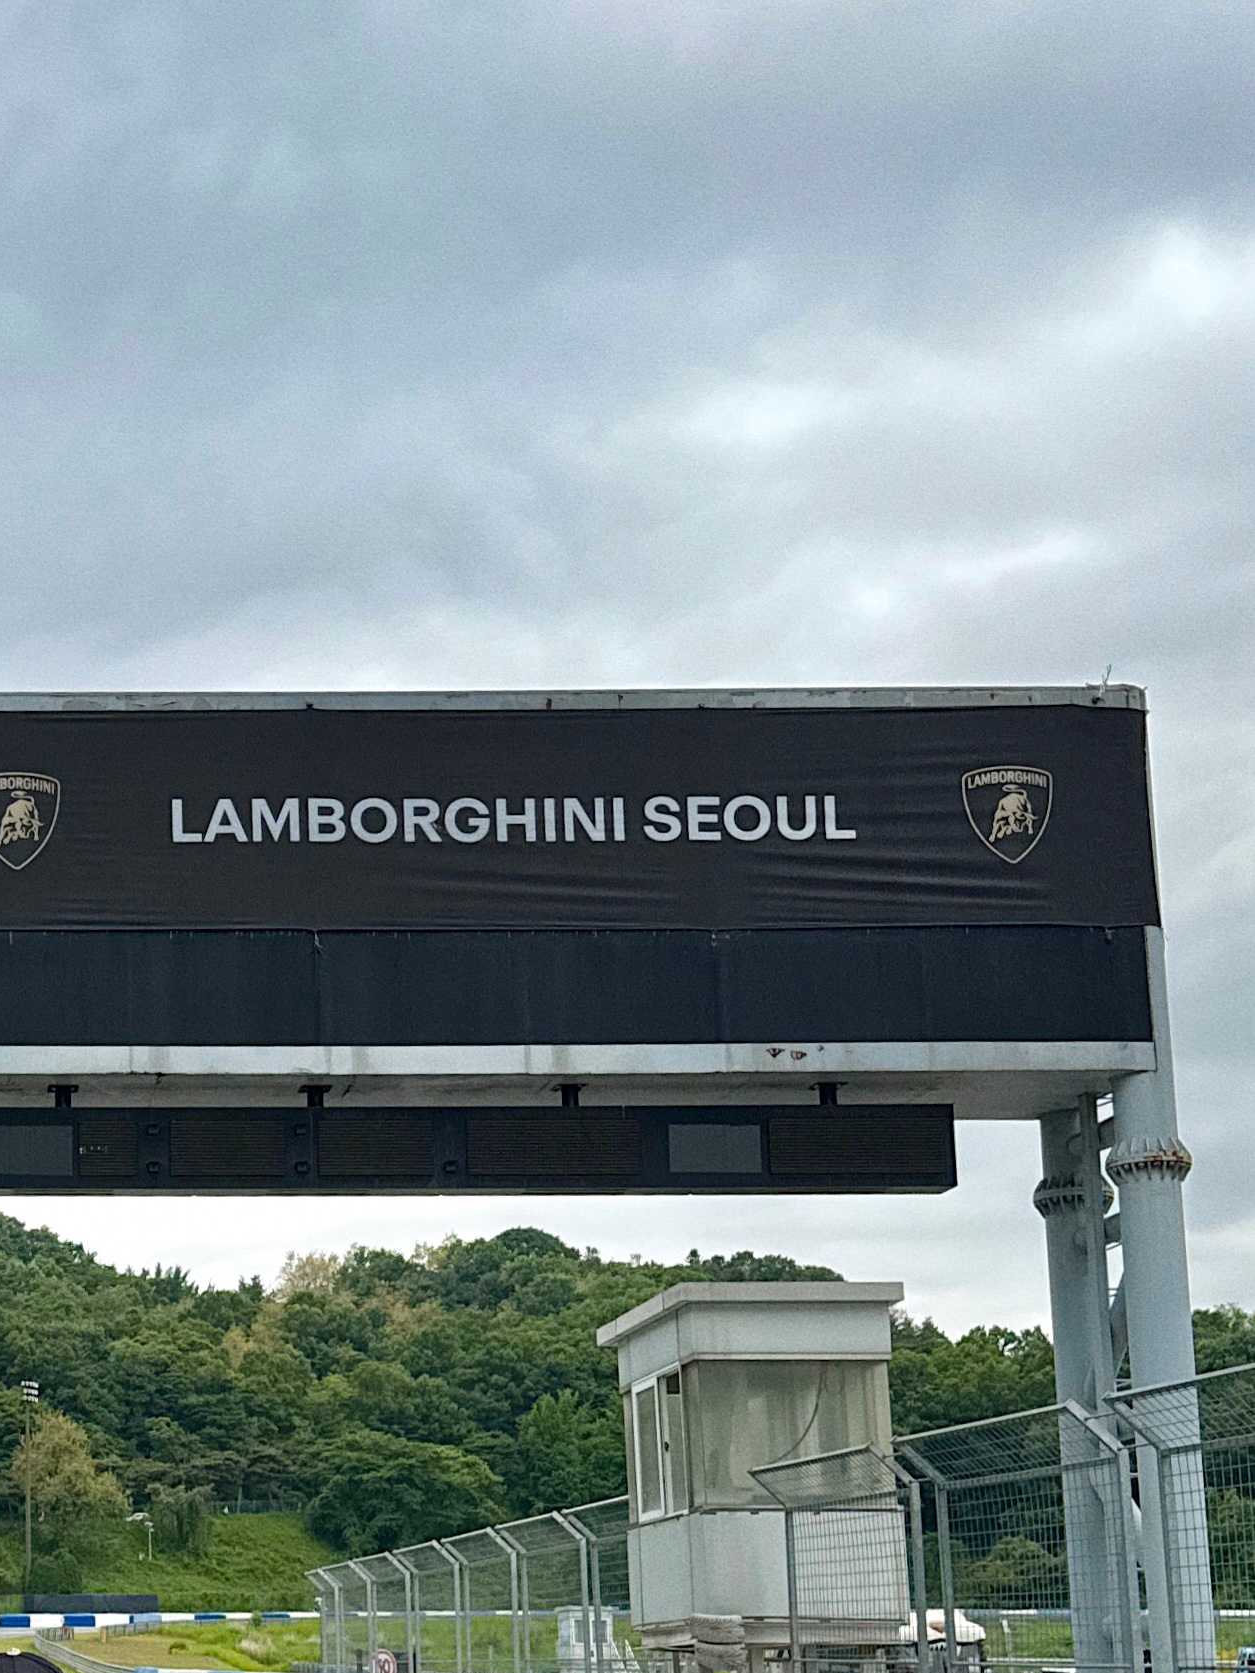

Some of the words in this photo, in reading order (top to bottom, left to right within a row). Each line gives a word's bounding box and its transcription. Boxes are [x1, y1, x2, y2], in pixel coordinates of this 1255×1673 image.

[967, 770, 1048, 790] LAMBORGHINI
[171, 797, 625, 843] LAMBORGHINI
[643, 795, 857, 842] SEOUL
